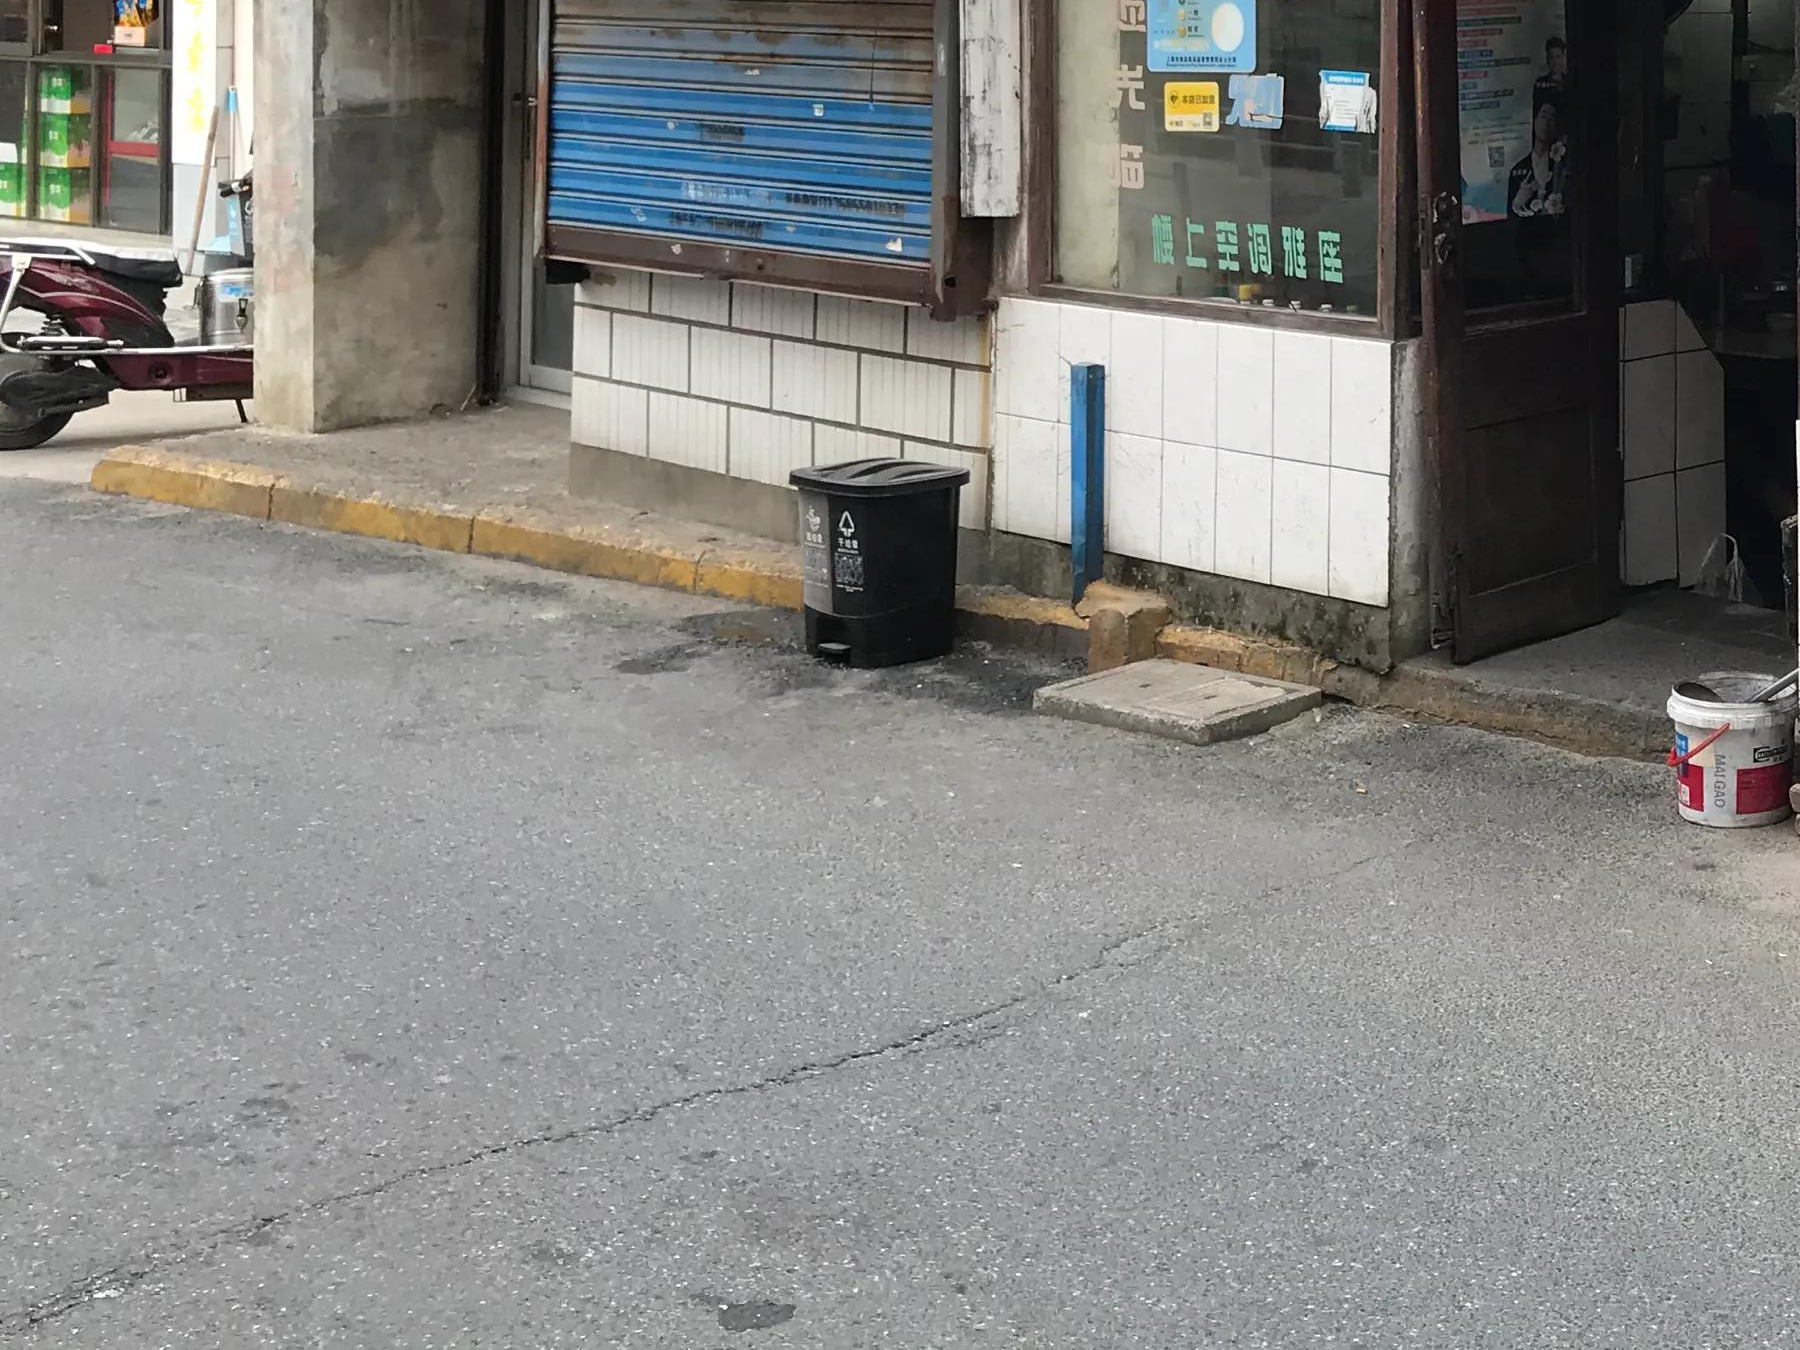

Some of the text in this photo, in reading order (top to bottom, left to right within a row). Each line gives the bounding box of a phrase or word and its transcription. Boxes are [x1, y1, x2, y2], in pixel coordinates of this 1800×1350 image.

[1151, 214, 1344, 283] 楼上空调雅座
